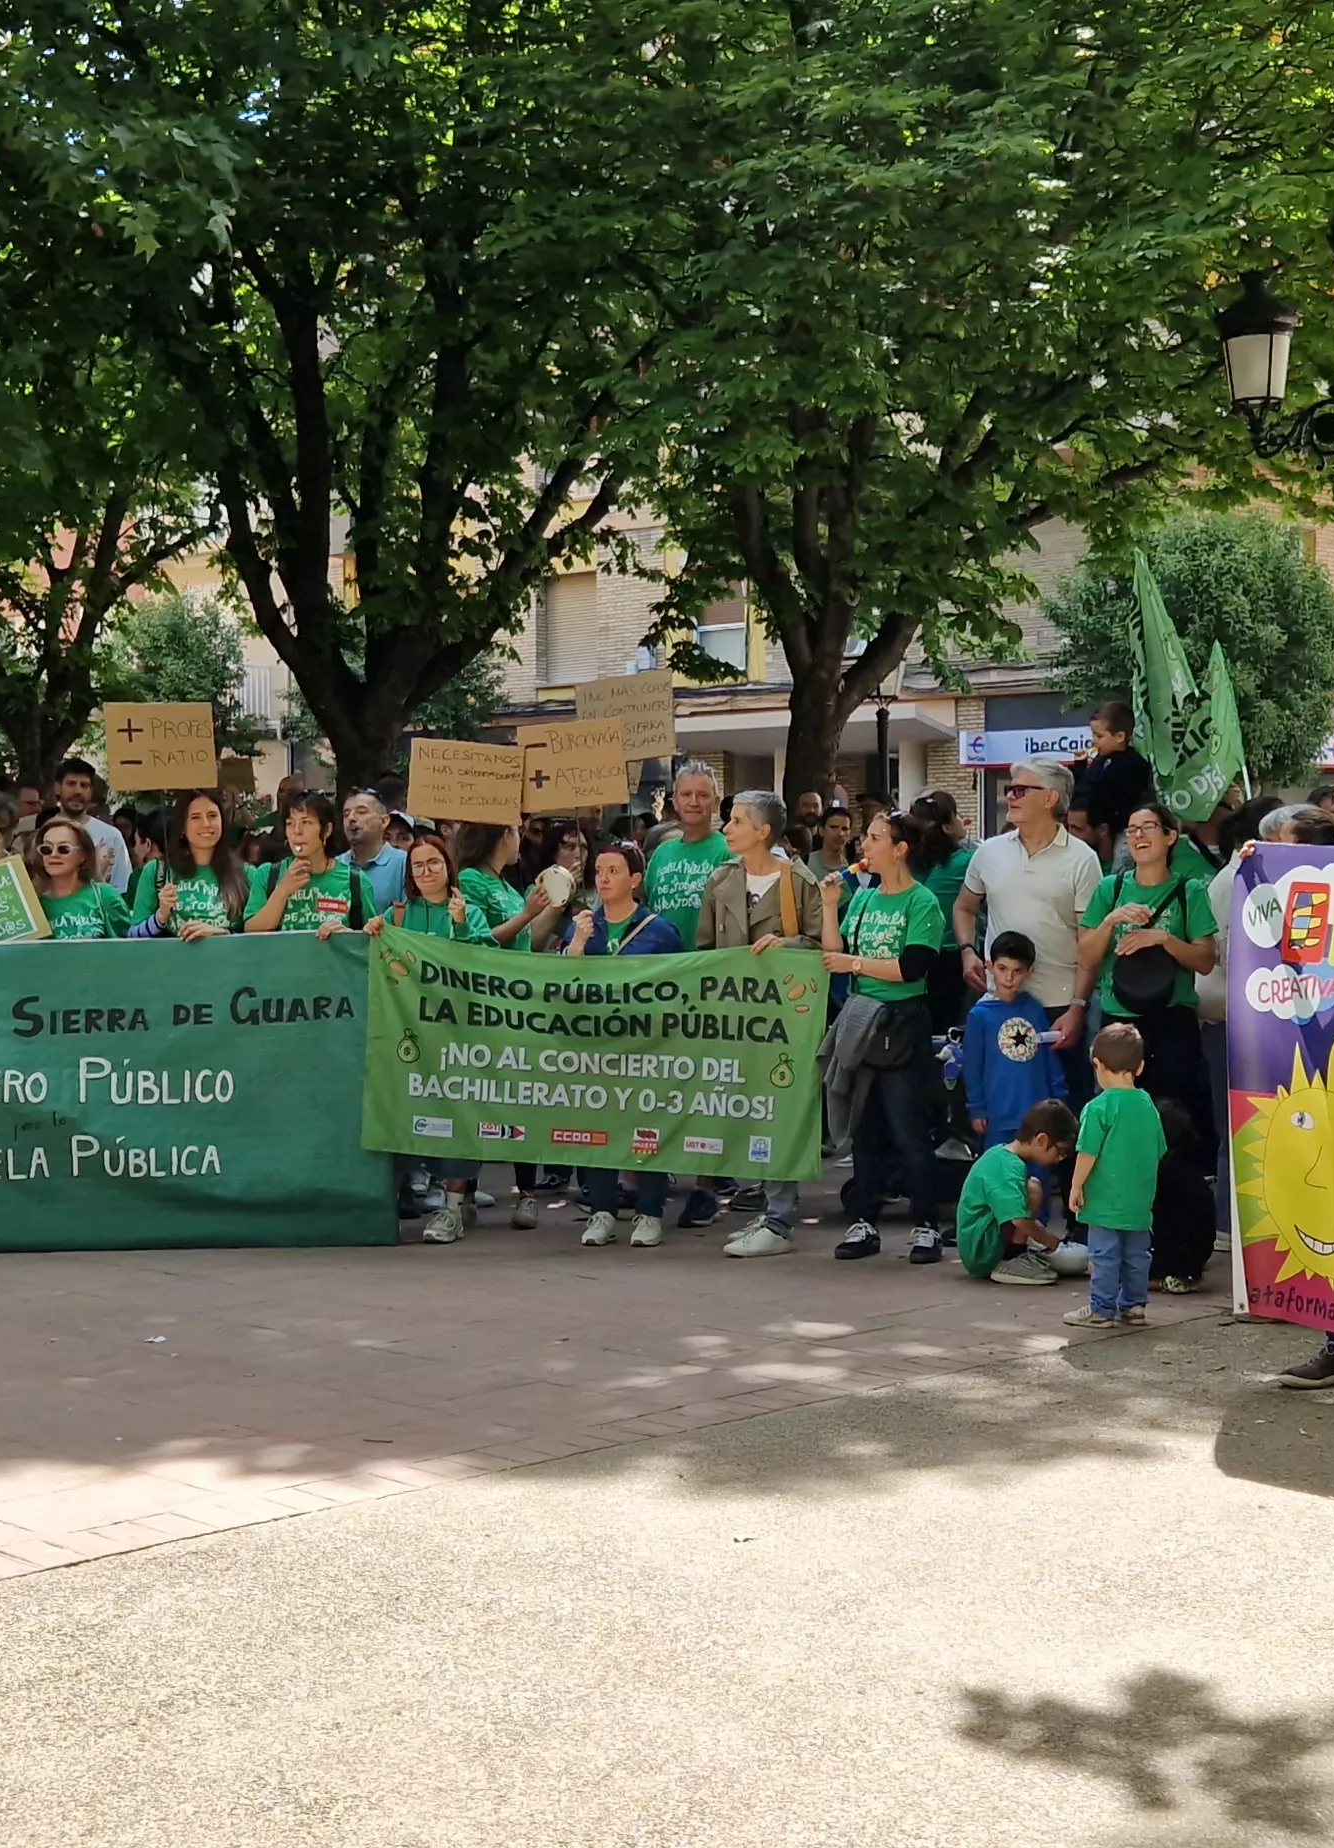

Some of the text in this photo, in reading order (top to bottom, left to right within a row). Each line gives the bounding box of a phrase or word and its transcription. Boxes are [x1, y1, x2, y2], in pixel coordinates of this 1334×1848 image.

[149, 750, 208, 766] RATIO
[571, 785, 604, 798] REAL
[1247, 896, 1283, 928] VIVA
[420, 960, 783, 1007] DINERO PÚBLICO, PARA
[12, 996, 150, 1039] SIERRA
[172, 1003, 213, 1026] DE
[229, 986, 355, 1028] GUARA
[419, 996, 789, 1044] LA EDUCACIÓN PÚBLICA
[78, 1057, 235, 1104] PÚBLICO
[440, 1042, 746, 1085] ¡NO AL CONCIERTO DEL
[408, 1073, 775, 1121] BACHILLERATO Y 0-3 AÑOS!
[70, 1135, 222, 1178] PÚBLICA
